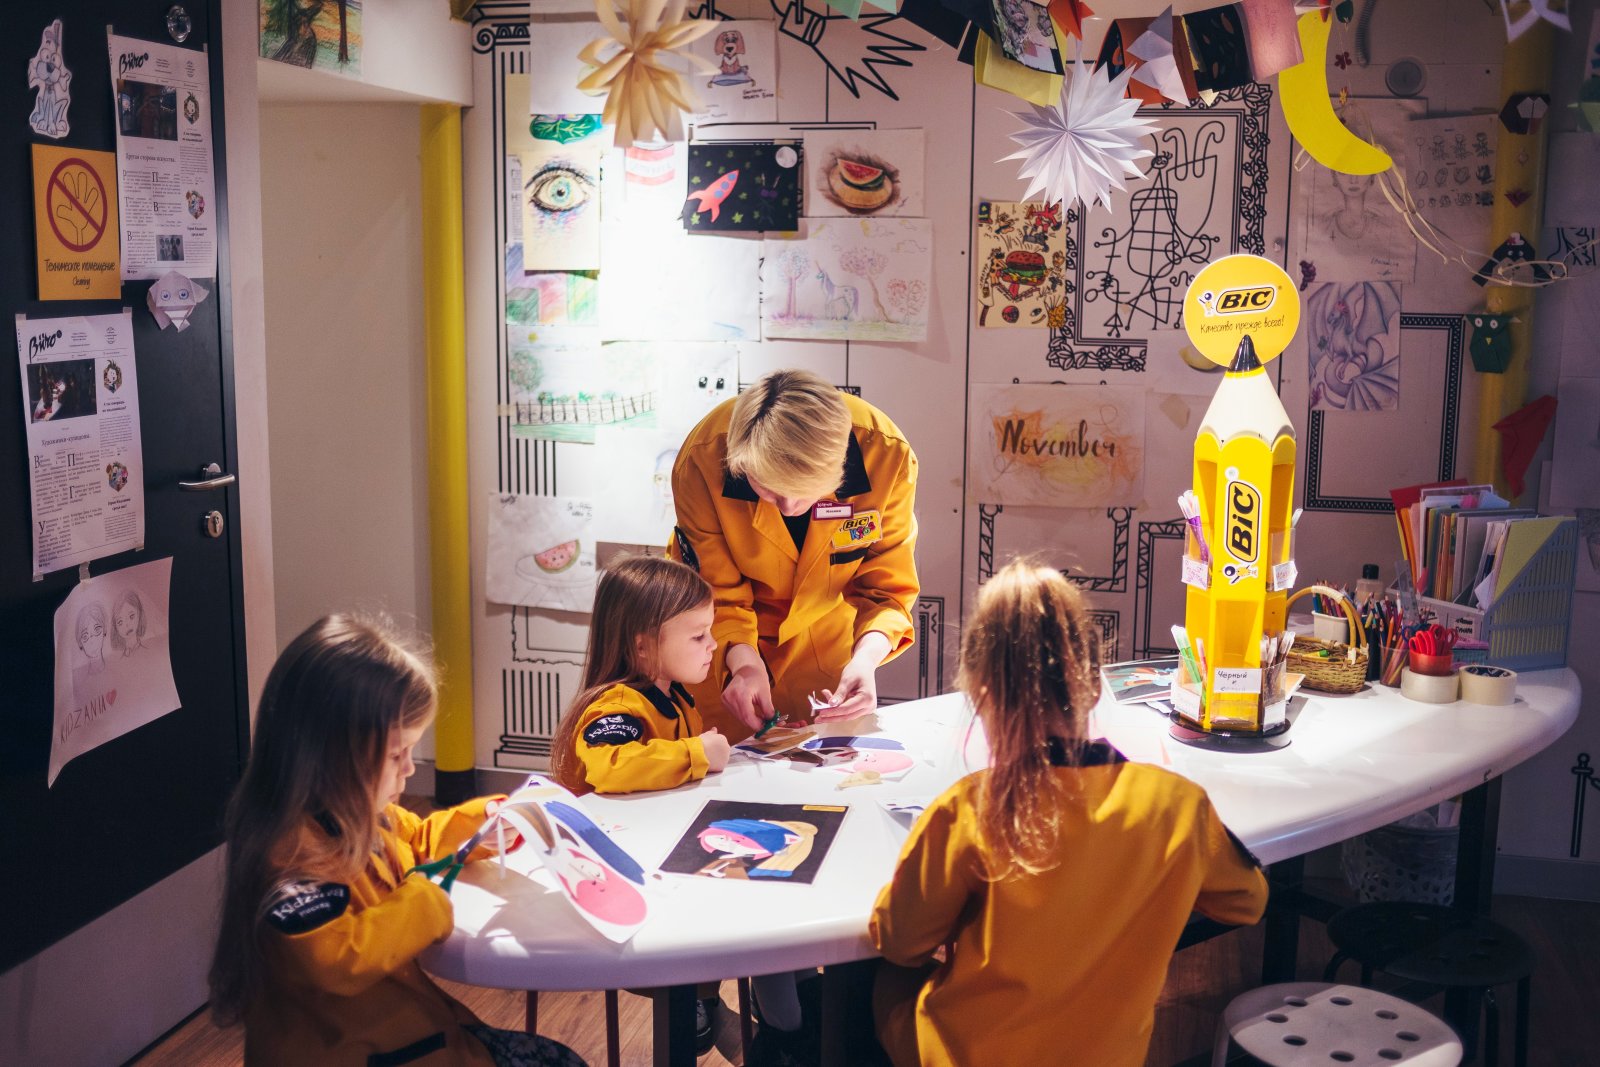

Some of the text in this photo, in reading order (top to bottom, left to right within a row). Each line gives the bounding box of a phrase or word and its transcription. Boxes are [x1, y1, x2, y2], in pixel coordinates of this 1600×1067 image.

[44, 259, 115, 274] Техническое помещение
[1201, 315, 1285, 334] Качество прежде всего!
[1001, 419, 1115, 457] November
[60, 694, 107, 744] KIDZANIA
